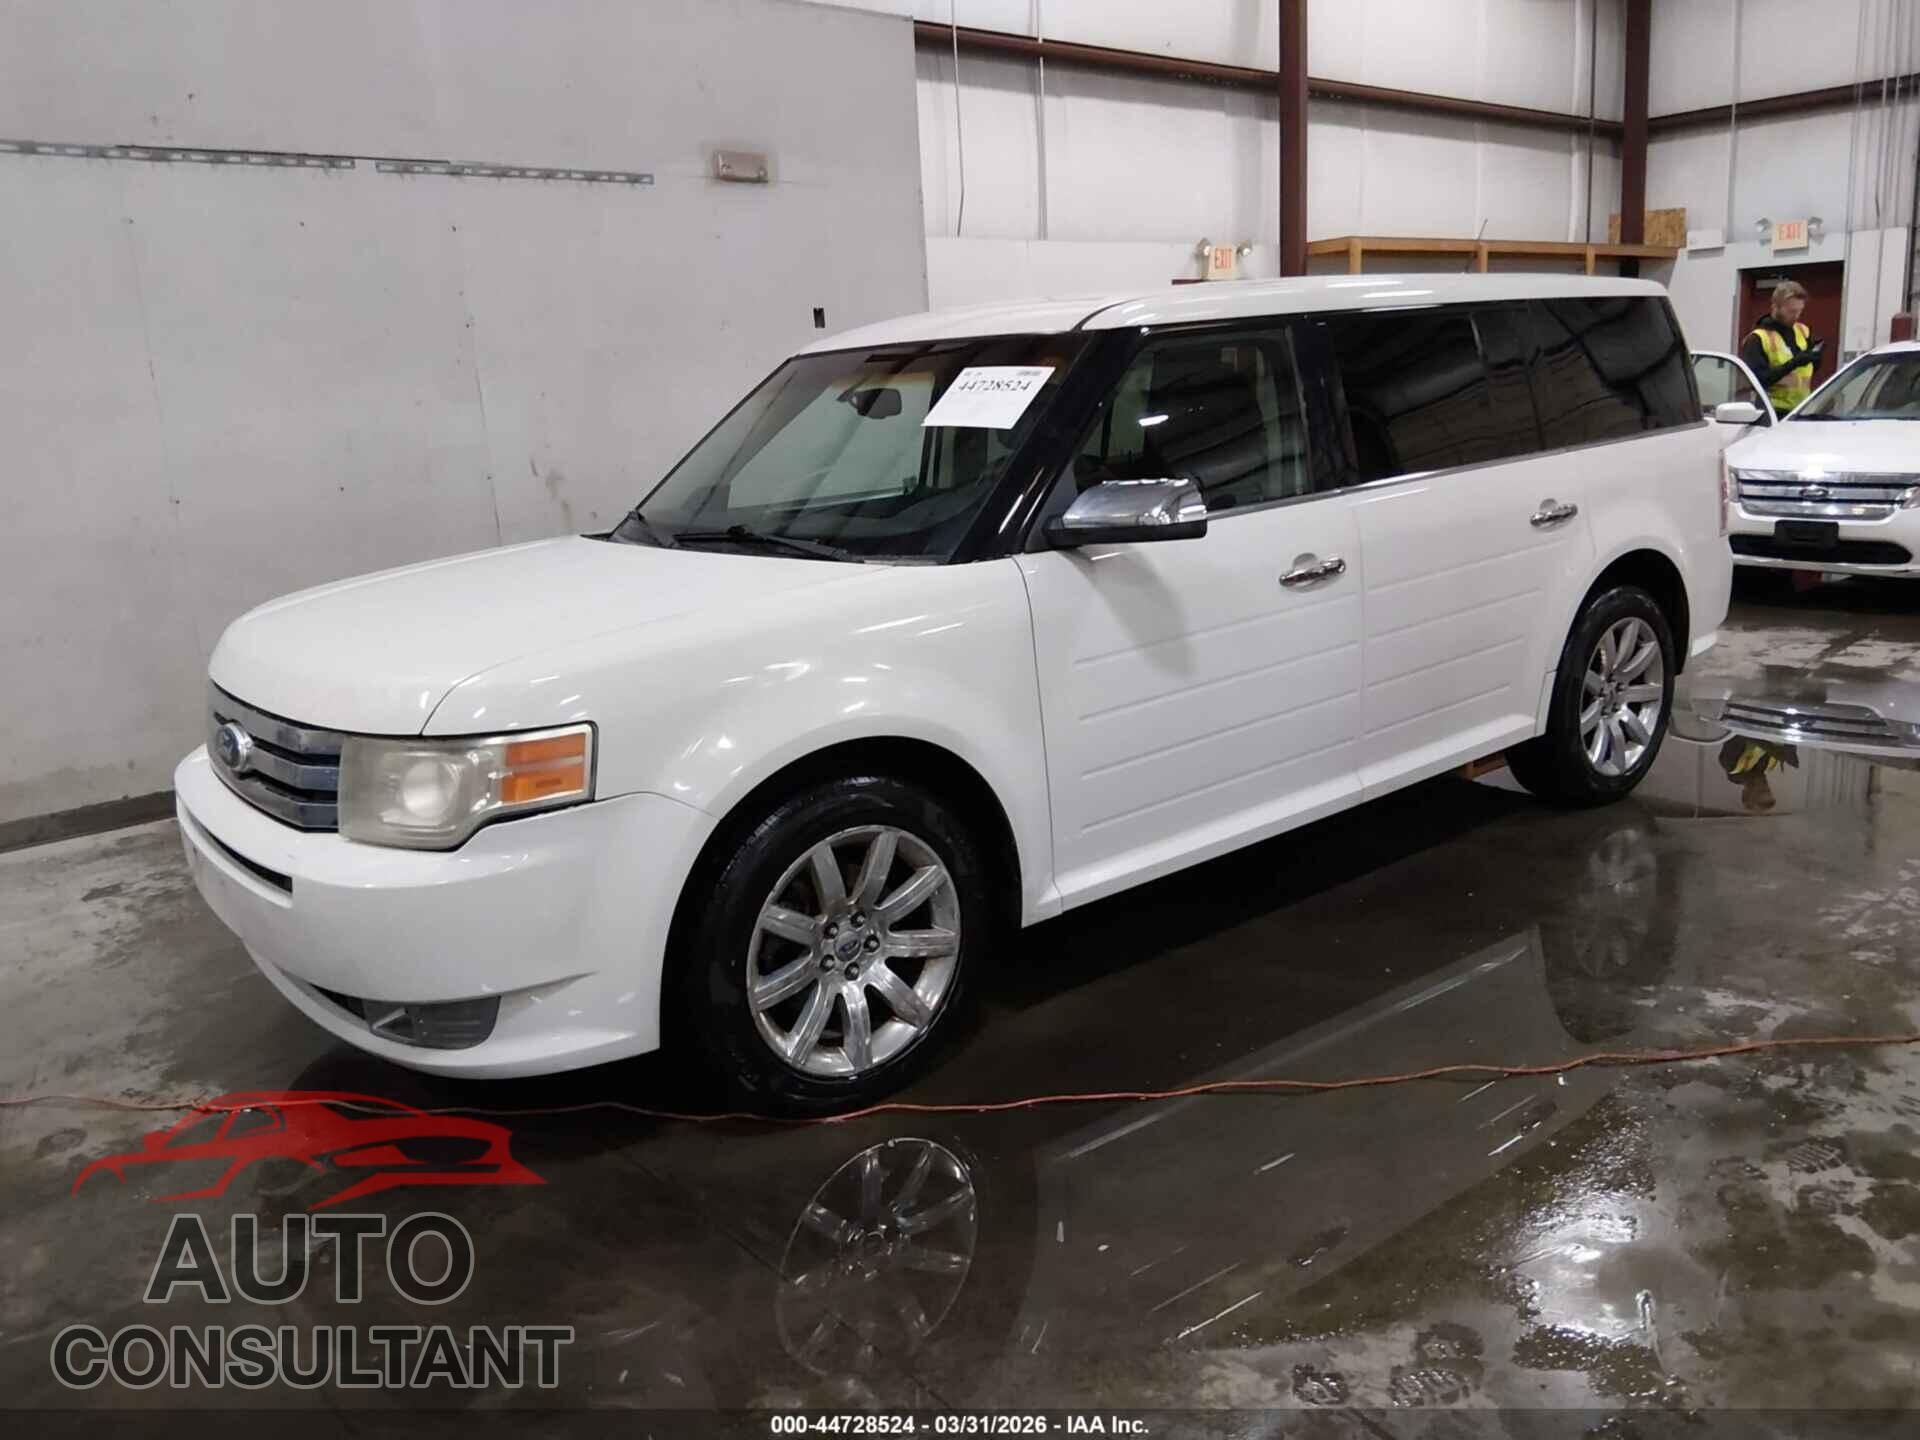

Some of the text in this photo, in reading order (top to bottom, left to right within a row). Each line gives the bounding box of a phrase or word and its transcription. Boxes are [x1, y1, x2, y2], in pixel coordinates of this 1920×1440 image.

[1778, 222, 1801, 241] EXIT
[1214, 247, 1233, 269] EXIT
[958, 379, 1032, 392] 44728524
